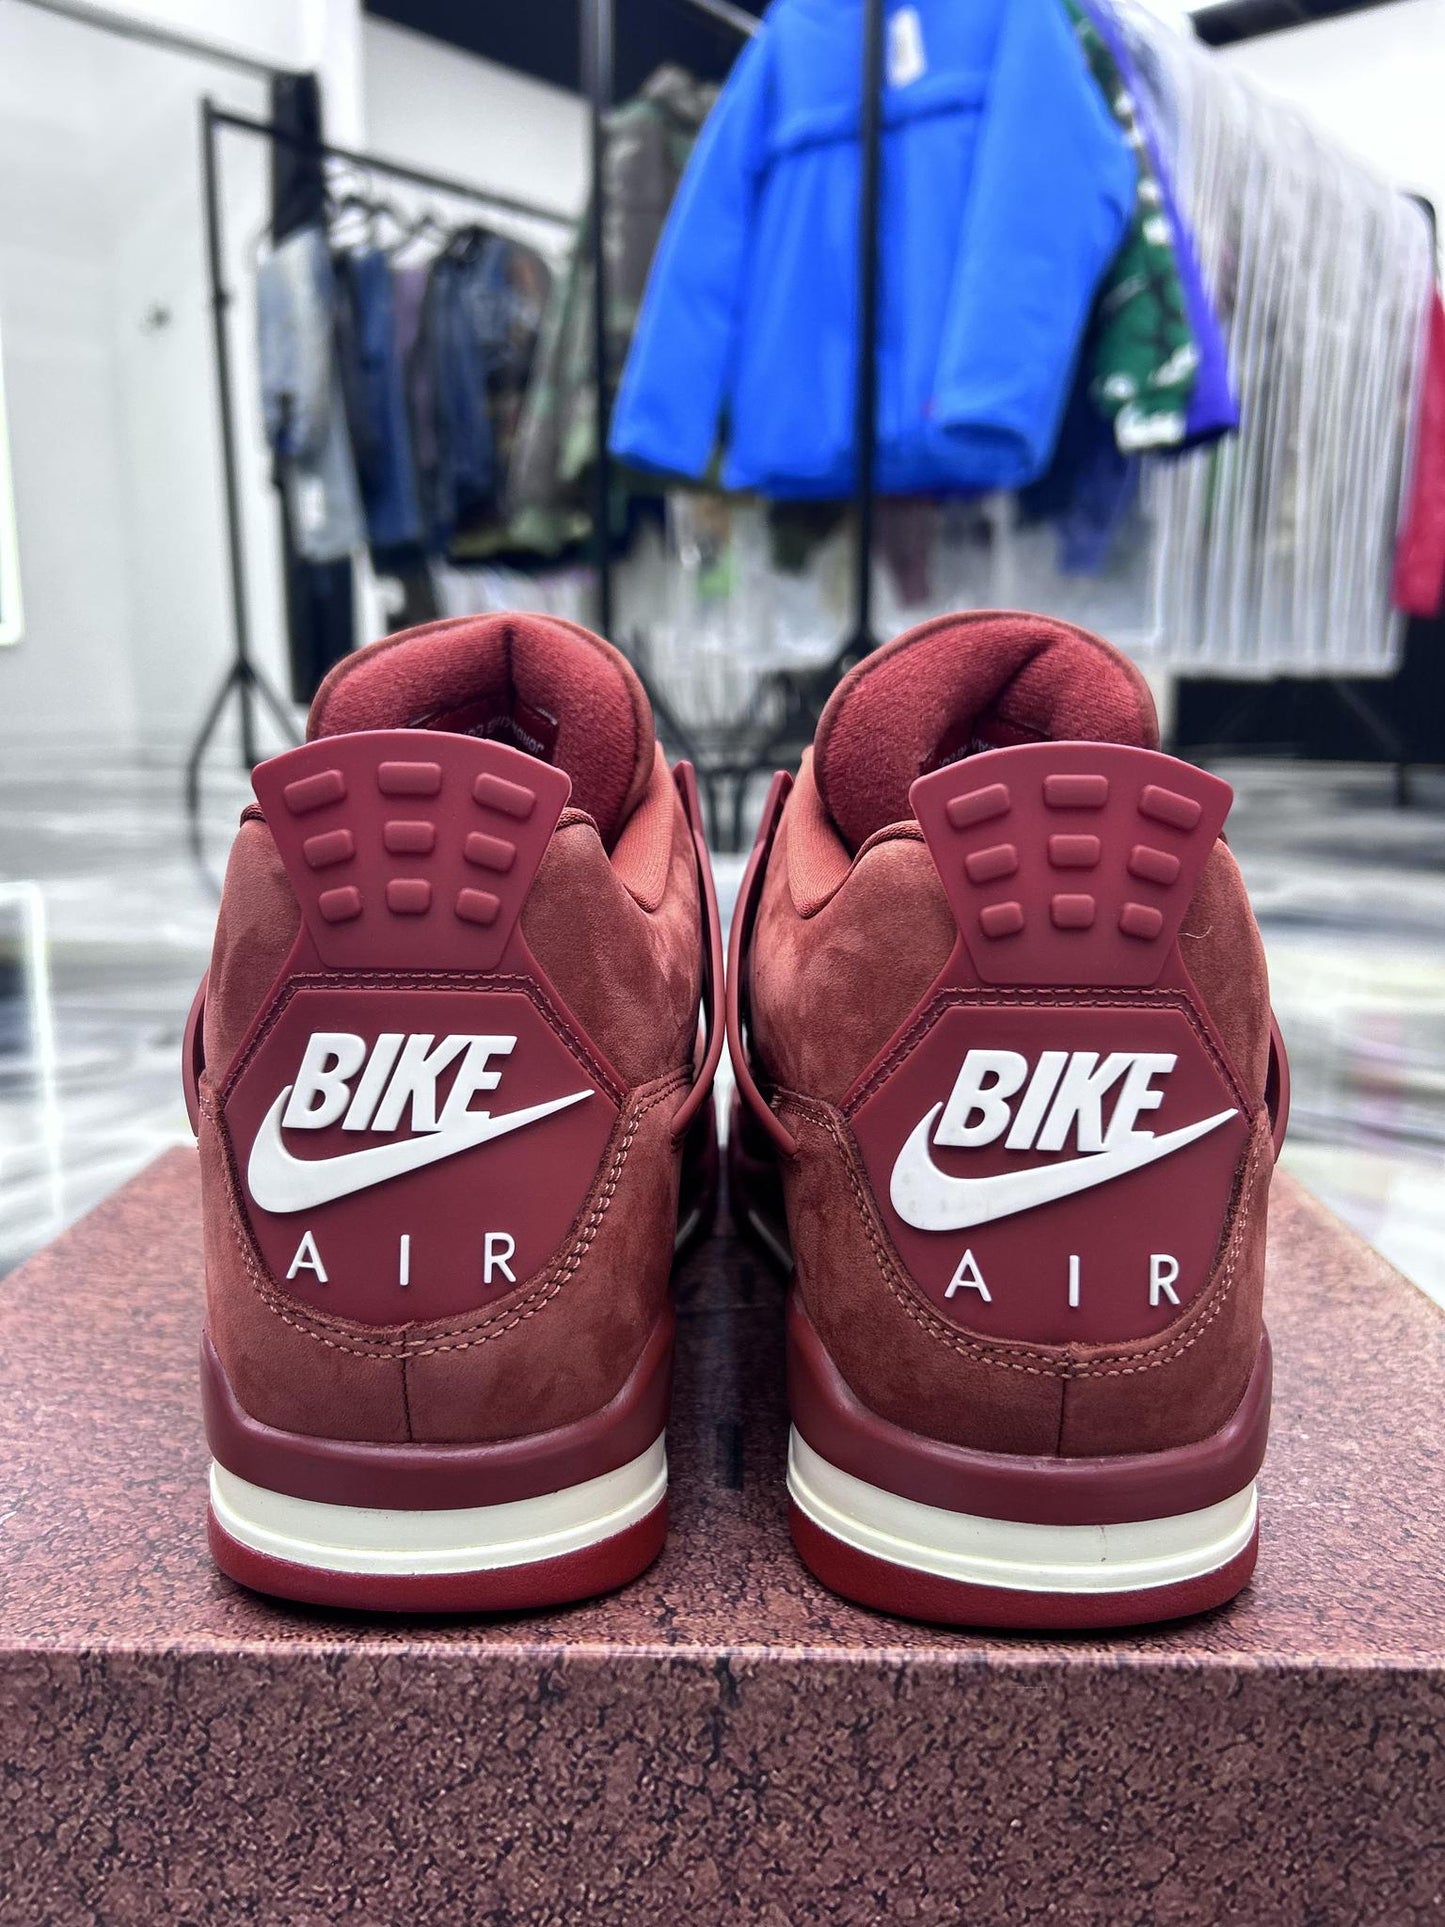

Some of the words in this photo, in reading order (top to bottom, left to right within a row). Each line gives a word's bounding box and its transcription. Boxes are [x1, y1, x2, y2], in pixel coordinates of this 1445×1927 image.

[281, 1032, 518, 1132] BIKE
[932, 1049, 1178, 1152] BIKE
[285, 1230, 517, 1286] AIR
[944, 1248, 1181, 1307] AIR
